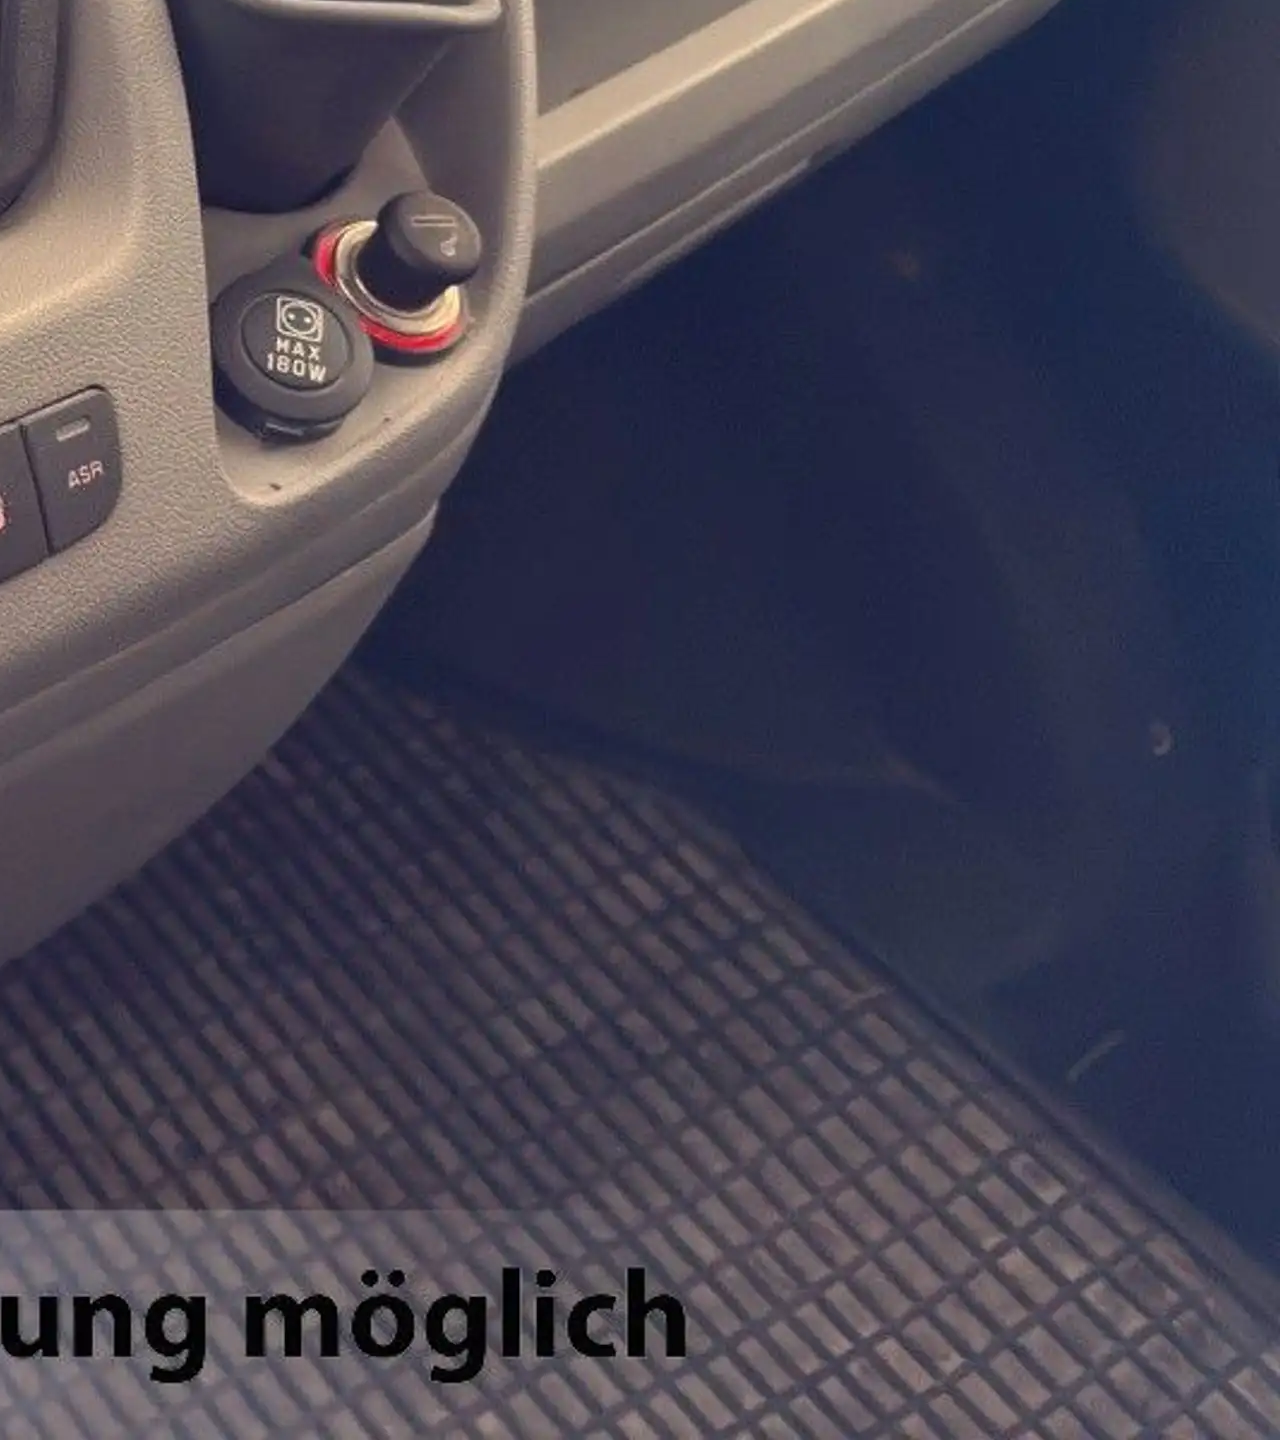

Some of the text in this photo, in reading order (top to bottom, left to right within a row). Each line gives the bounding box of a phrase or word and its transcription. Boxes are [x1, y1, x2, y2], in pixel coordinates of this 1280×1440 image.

[275, 337, 321, 362] MAX
[266, 353, 327, 384] 180W
[68, 460, 105, 489] ASR
